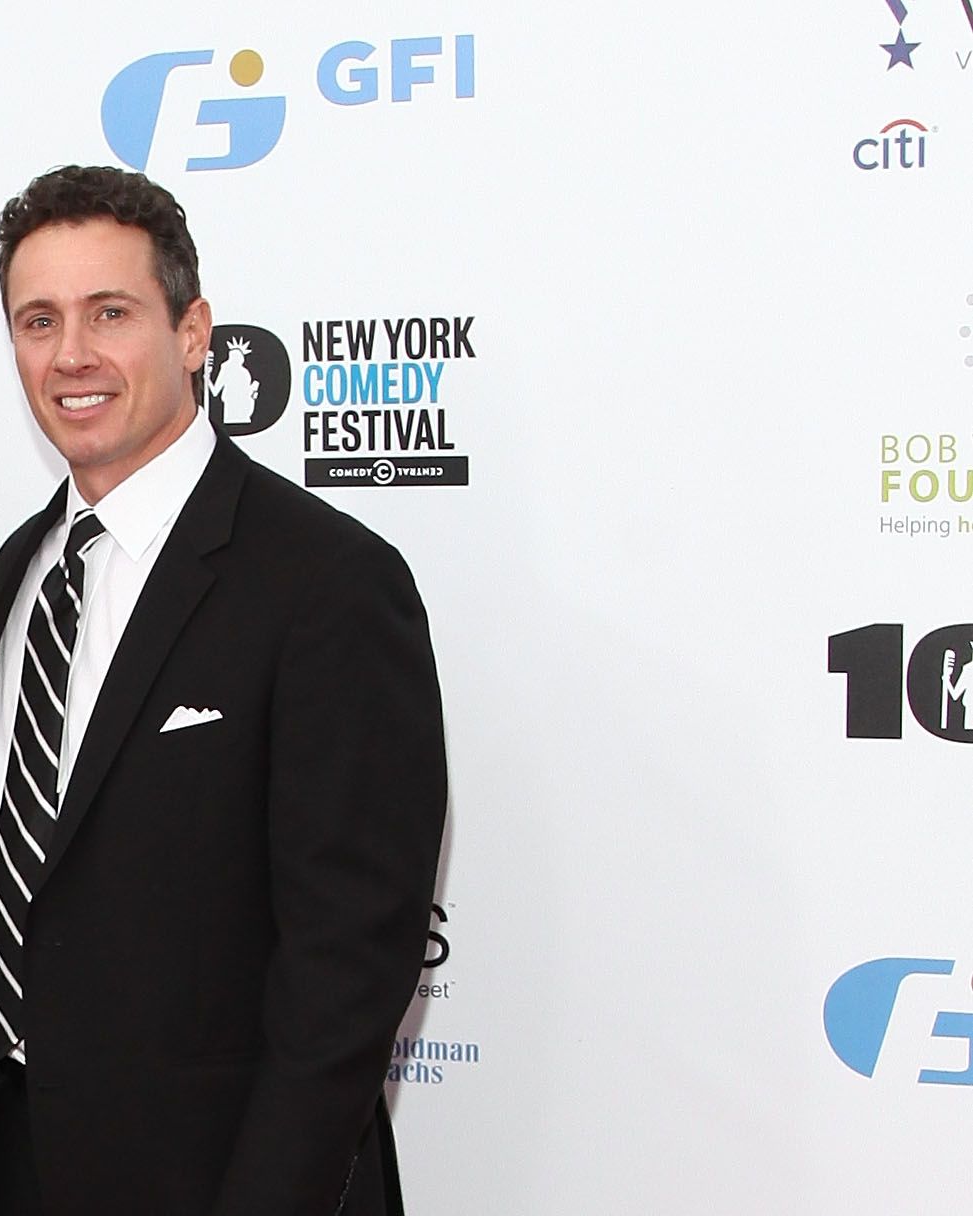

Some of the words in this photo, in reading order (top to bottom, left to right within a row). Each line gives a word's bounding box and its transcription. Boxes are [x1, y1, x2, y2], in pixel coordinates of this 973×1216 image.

[317, 35, 475, 105] GFI
[853, 127, 925, 170] citi
[303, 319, 376, 362] NEW
[383, 316, 476, 360] YORK
[303, 362, 445, 406] COMEDY
[303, 409, 455, 452] FESTIVAL
[881, 434, 957, 464] BOB
[329, 467, 373, 477] COMEDY
[880, 515, 951, 538] Helping
